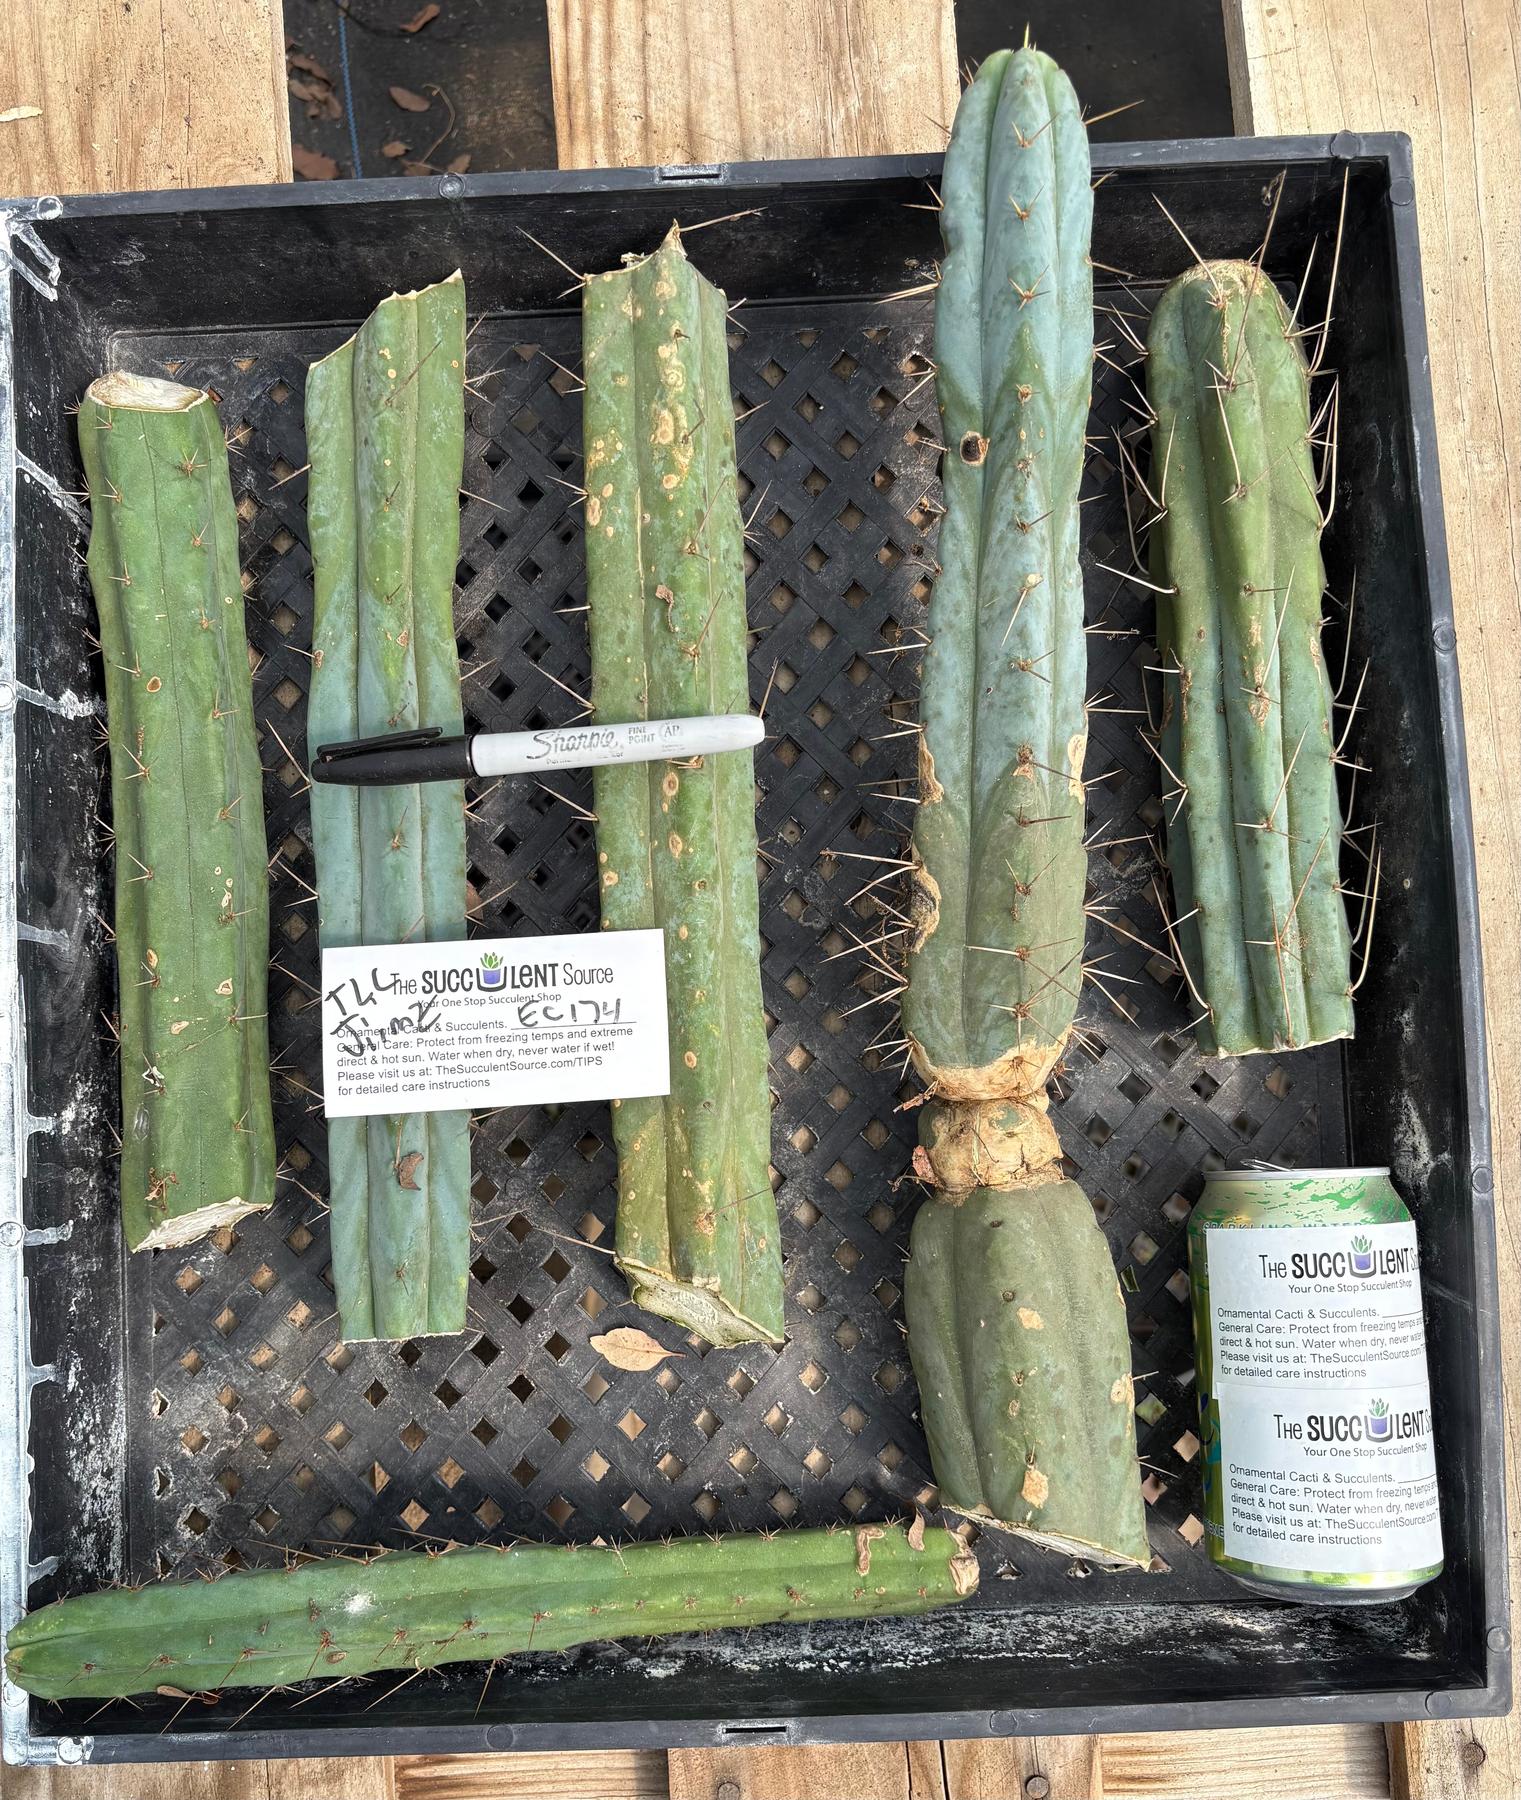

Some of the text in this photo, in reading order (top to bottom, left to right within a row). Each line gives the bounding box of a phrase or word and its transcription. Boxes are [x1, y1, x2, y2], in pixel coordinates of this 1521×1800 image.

[628, 726, 648, 735] FINE
[628, 733, 655, 745] POINT
[563, 962, 614, 986] Source
[417, 993, 562, 1009] Your One Stop Succulent Shop
[434, 1023, 442, 1032] &
[445, 1020, 507, 1032] Succulents.
[383, 1039, 413, 1050] Care:
[416, 1036, 455, 1048] Protect
[458, 1035, 483, 1045] from
[486, 1032, 528, 1045] freezing
[532, 1030, 564, 1042] temps
[567, 1029, 587, 1039] and
[590, 1027, 633, 1038] extreme
[337, 1041, 615, 1067] direct & hot sun. Water when dry, never water if wet!
[337, 1055, 603, 1082] Please visit us at: TheSucculentSource.com/TIPS
[338, 1078, 490, 1096] for detailed care instructions
[1288, 1278, 1412, 1294] Your One Stop Succulent Shop
[1217, 1307, 1380, 1320] Ornamental Cacti & Succulents.
[1218, 1321, 1253, 1333] General
[1256, 1323, 1286, 1334] Care:
[1289, 1323, 1330, 1334] Protect
[1332, 1323, 1359, 1334] from
[1360, 1321, 1396, 1333] freezing
[1397, 1317, 1416, 1329] temps
[1219, 1337, 1243, 1348] direct
[1245, 1338, 1253, 1348] &
[1255, 1338, 1273, 1349] hot
[1275, 1340, 1299, 1349] sun.
[1302, 1339, 1337, 1349] Water
[1339, 1338, 1368, 1348] when
[1370, 1336, 1387, 1349] dry,
[1389, 1335, 1409, 1345] never
[1220, 1350, 1250, 1362] Please
[1252, 1352, 1274, 1363] visit
[1276, 1355, 1289, 1364] us
[1292, 1354, 1307, 1364] at:
[1221, 1365, 1367, 1379] for detailed care instructions
[1303, 1441, 1428, 1459] Your One Stop Succulent Shop
[1229, 1463, 1396, 1483] Ornamental Cacti & Succulents.
[1230, 1478, 1267, 1494] General
[1269, 1484, 1300, 1497] Care:
[1303, 1487, 1346, 1499] Protect
[1348, 1488, 1373, 1499] from
[1376, 1486, 1412, 1498] freezing
[1414, 1482, 1431, 1495] temps
[1231, 1492, 1255, 1507] direct
[1258, 1497, 1265, 1508] &
[1268, 1499, 1286, 1511] hot
[1289, 1504, 1313, 1513] sun.
[1316, 1503, 1351, 1515] Water
[1354, 1502, 1383, 1514] when
[1385, 1501, 1402, 1516] dry,
[1405, 1500, 1425, 1512] never
[1231, 1506, 1263, 1522] Please
[1265, 1512, 1287, 1526] visit
[1290, 1518, 1304, 1528] us
[1307, 1518, 1322, 1529] at:
[1232, 1521, 1244, 1533] for
[1246, 1524, 1286, 1541] detailed
[1289, 1533, 1314, 1544] care
[1318, 1533, 1383, 1546] instructions
